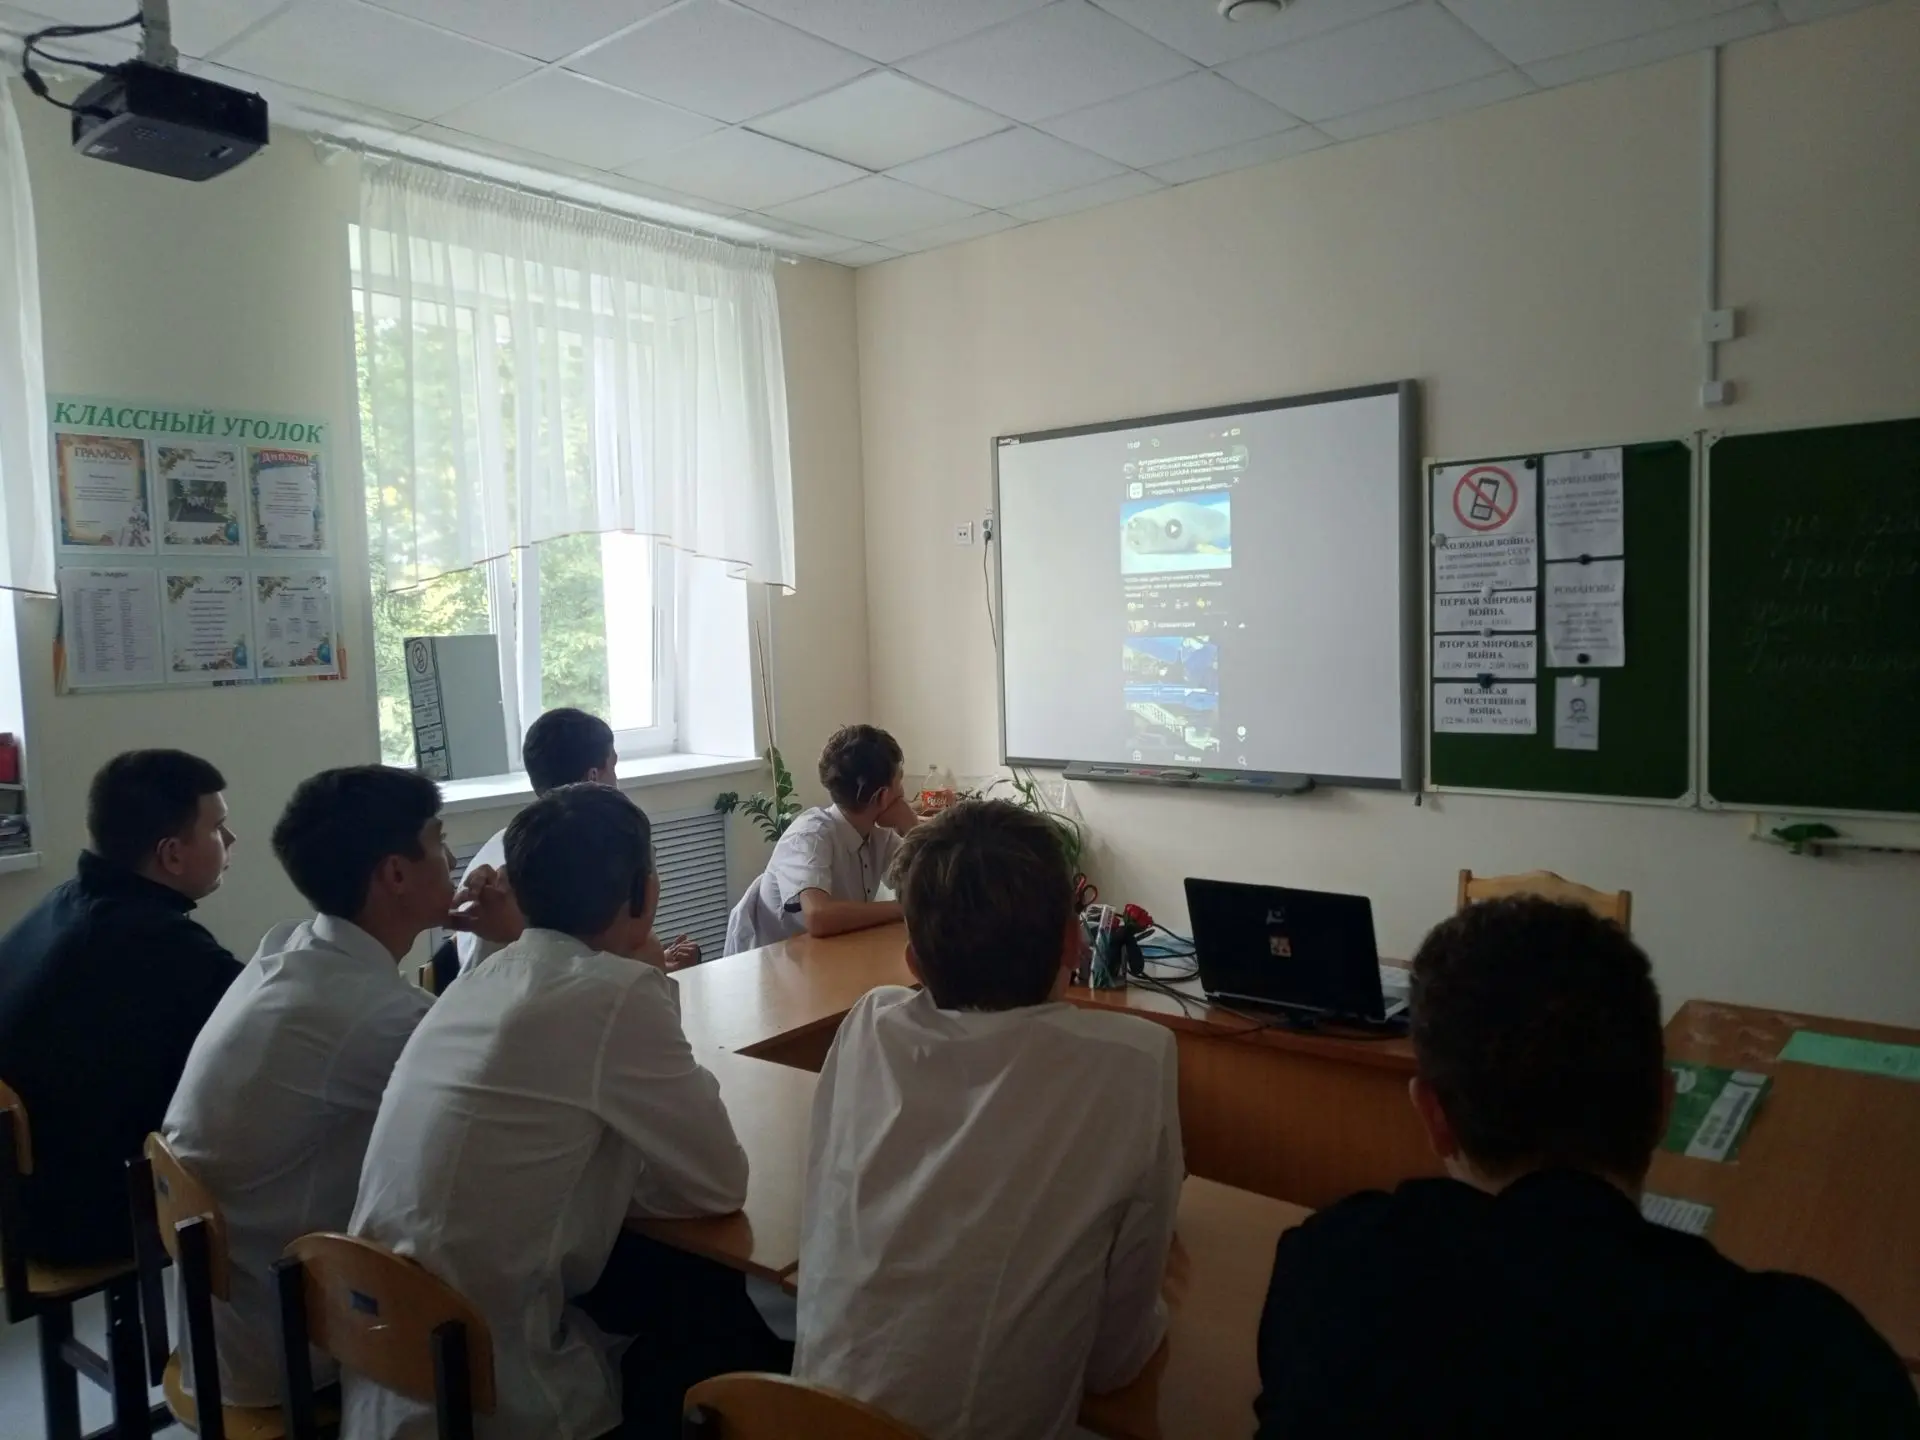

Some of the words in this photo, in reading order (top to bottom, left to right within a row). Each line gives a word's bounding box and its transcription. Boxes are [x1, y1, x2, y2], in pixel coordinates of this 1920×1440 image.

[53, 402, 215, 436] КЛАССНЫЙ
[221, 417, 324, 445] УГОЛОК
[1440, 598, 1480, 606] ПЕРВАЯ
[1483, 596, 1532, 605] МИРОВАЯ
[1468, 607, 1505, 616] ВОЙНА
[1467, 650, 1504, 659] ВОЙНА
[1445, 697, 1526, 705] ОТЕЧЕСТВЕННАЯ
[1469, 707, 1502, 716] ВОЙНА
